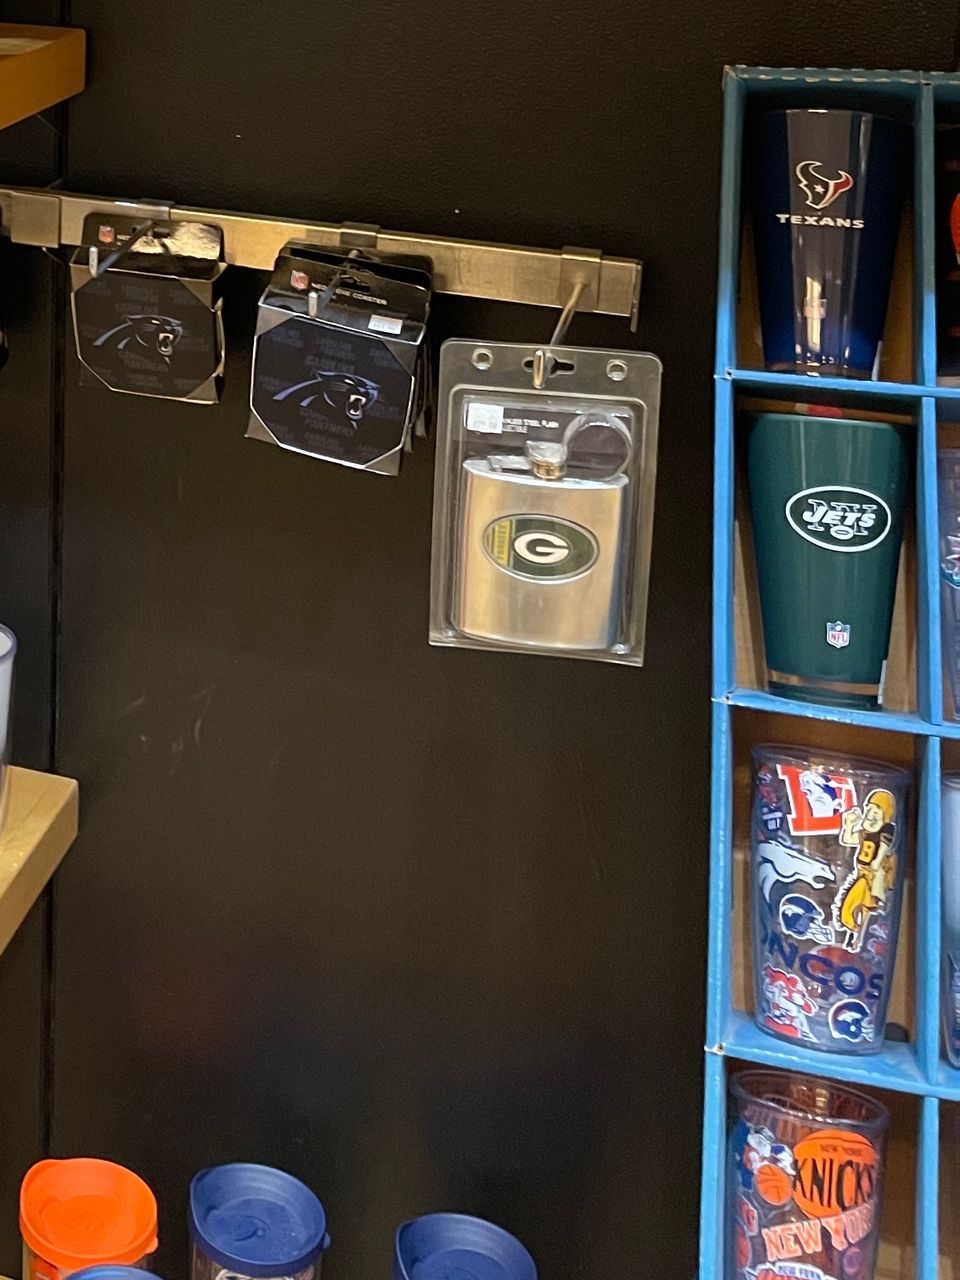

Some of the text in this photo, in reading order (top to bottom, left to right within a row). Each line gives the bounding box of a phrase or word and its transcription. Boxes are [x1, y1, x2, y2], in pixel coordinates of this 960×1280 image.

[775, 213, 865, 229] TEXANS
[802, 505, 876, 529] JETS
[514, 532, 570, 564] G
[761, 1219, 823, 1262] NEW
